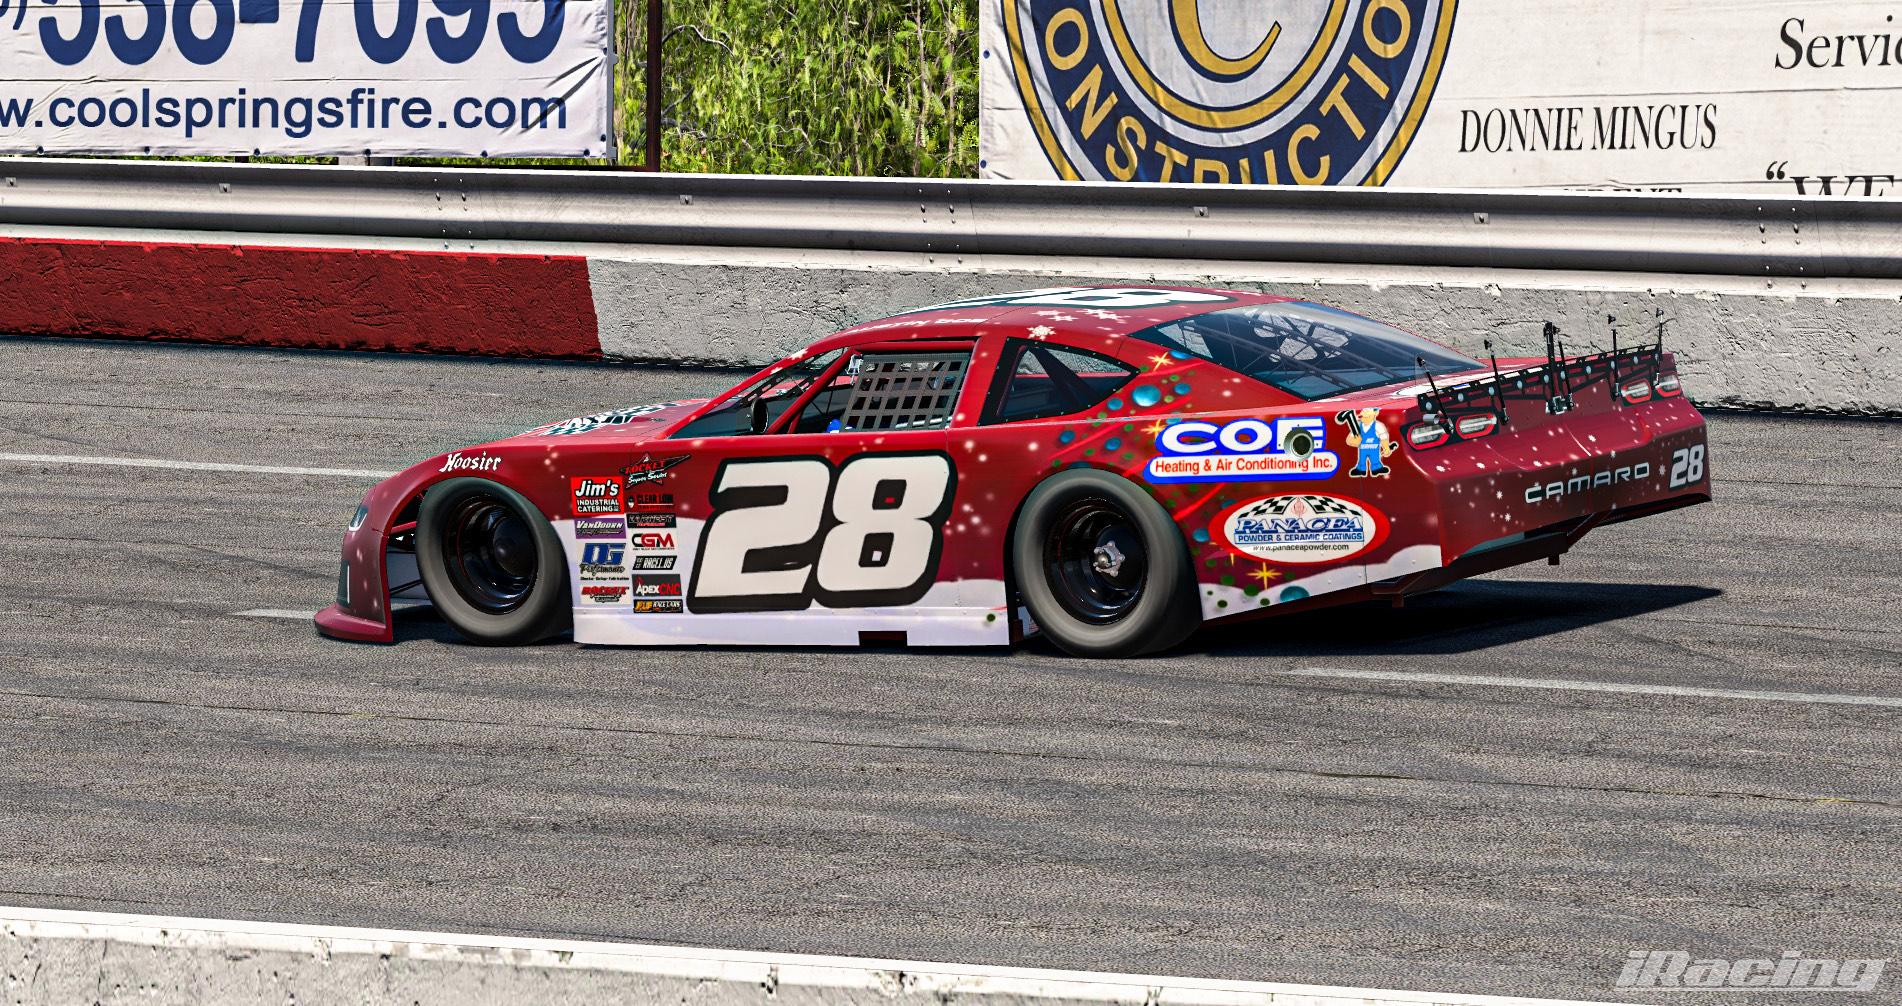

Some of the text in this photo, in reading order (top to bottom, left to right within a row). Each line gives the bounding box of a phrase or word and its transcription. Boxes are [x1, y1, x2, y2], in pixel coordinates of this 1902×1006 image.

[1458, 103, 1718, 153] DONNIE MINGUS
[438, 451, 502, 473] Hoosier
[1155, 457, 1199, 474] Heating
[1204, 458, 1212, 471] &
[1216, 458, 1232, 470] Air
[1313, 456, 1333, 468] Inc.
[1669, 443, 1706, 489] 28
[575, 480, 619, 497] Jim's
[1525, 461, 1650, 505] CAMARO
[689, 452, 956, 612] 28
[1235, 517, 1364, 533] PANACEA
[1323, 533, 1363, 541] COATINGS
[1253, 544, 1349, 552] www.panaceapowder.com
